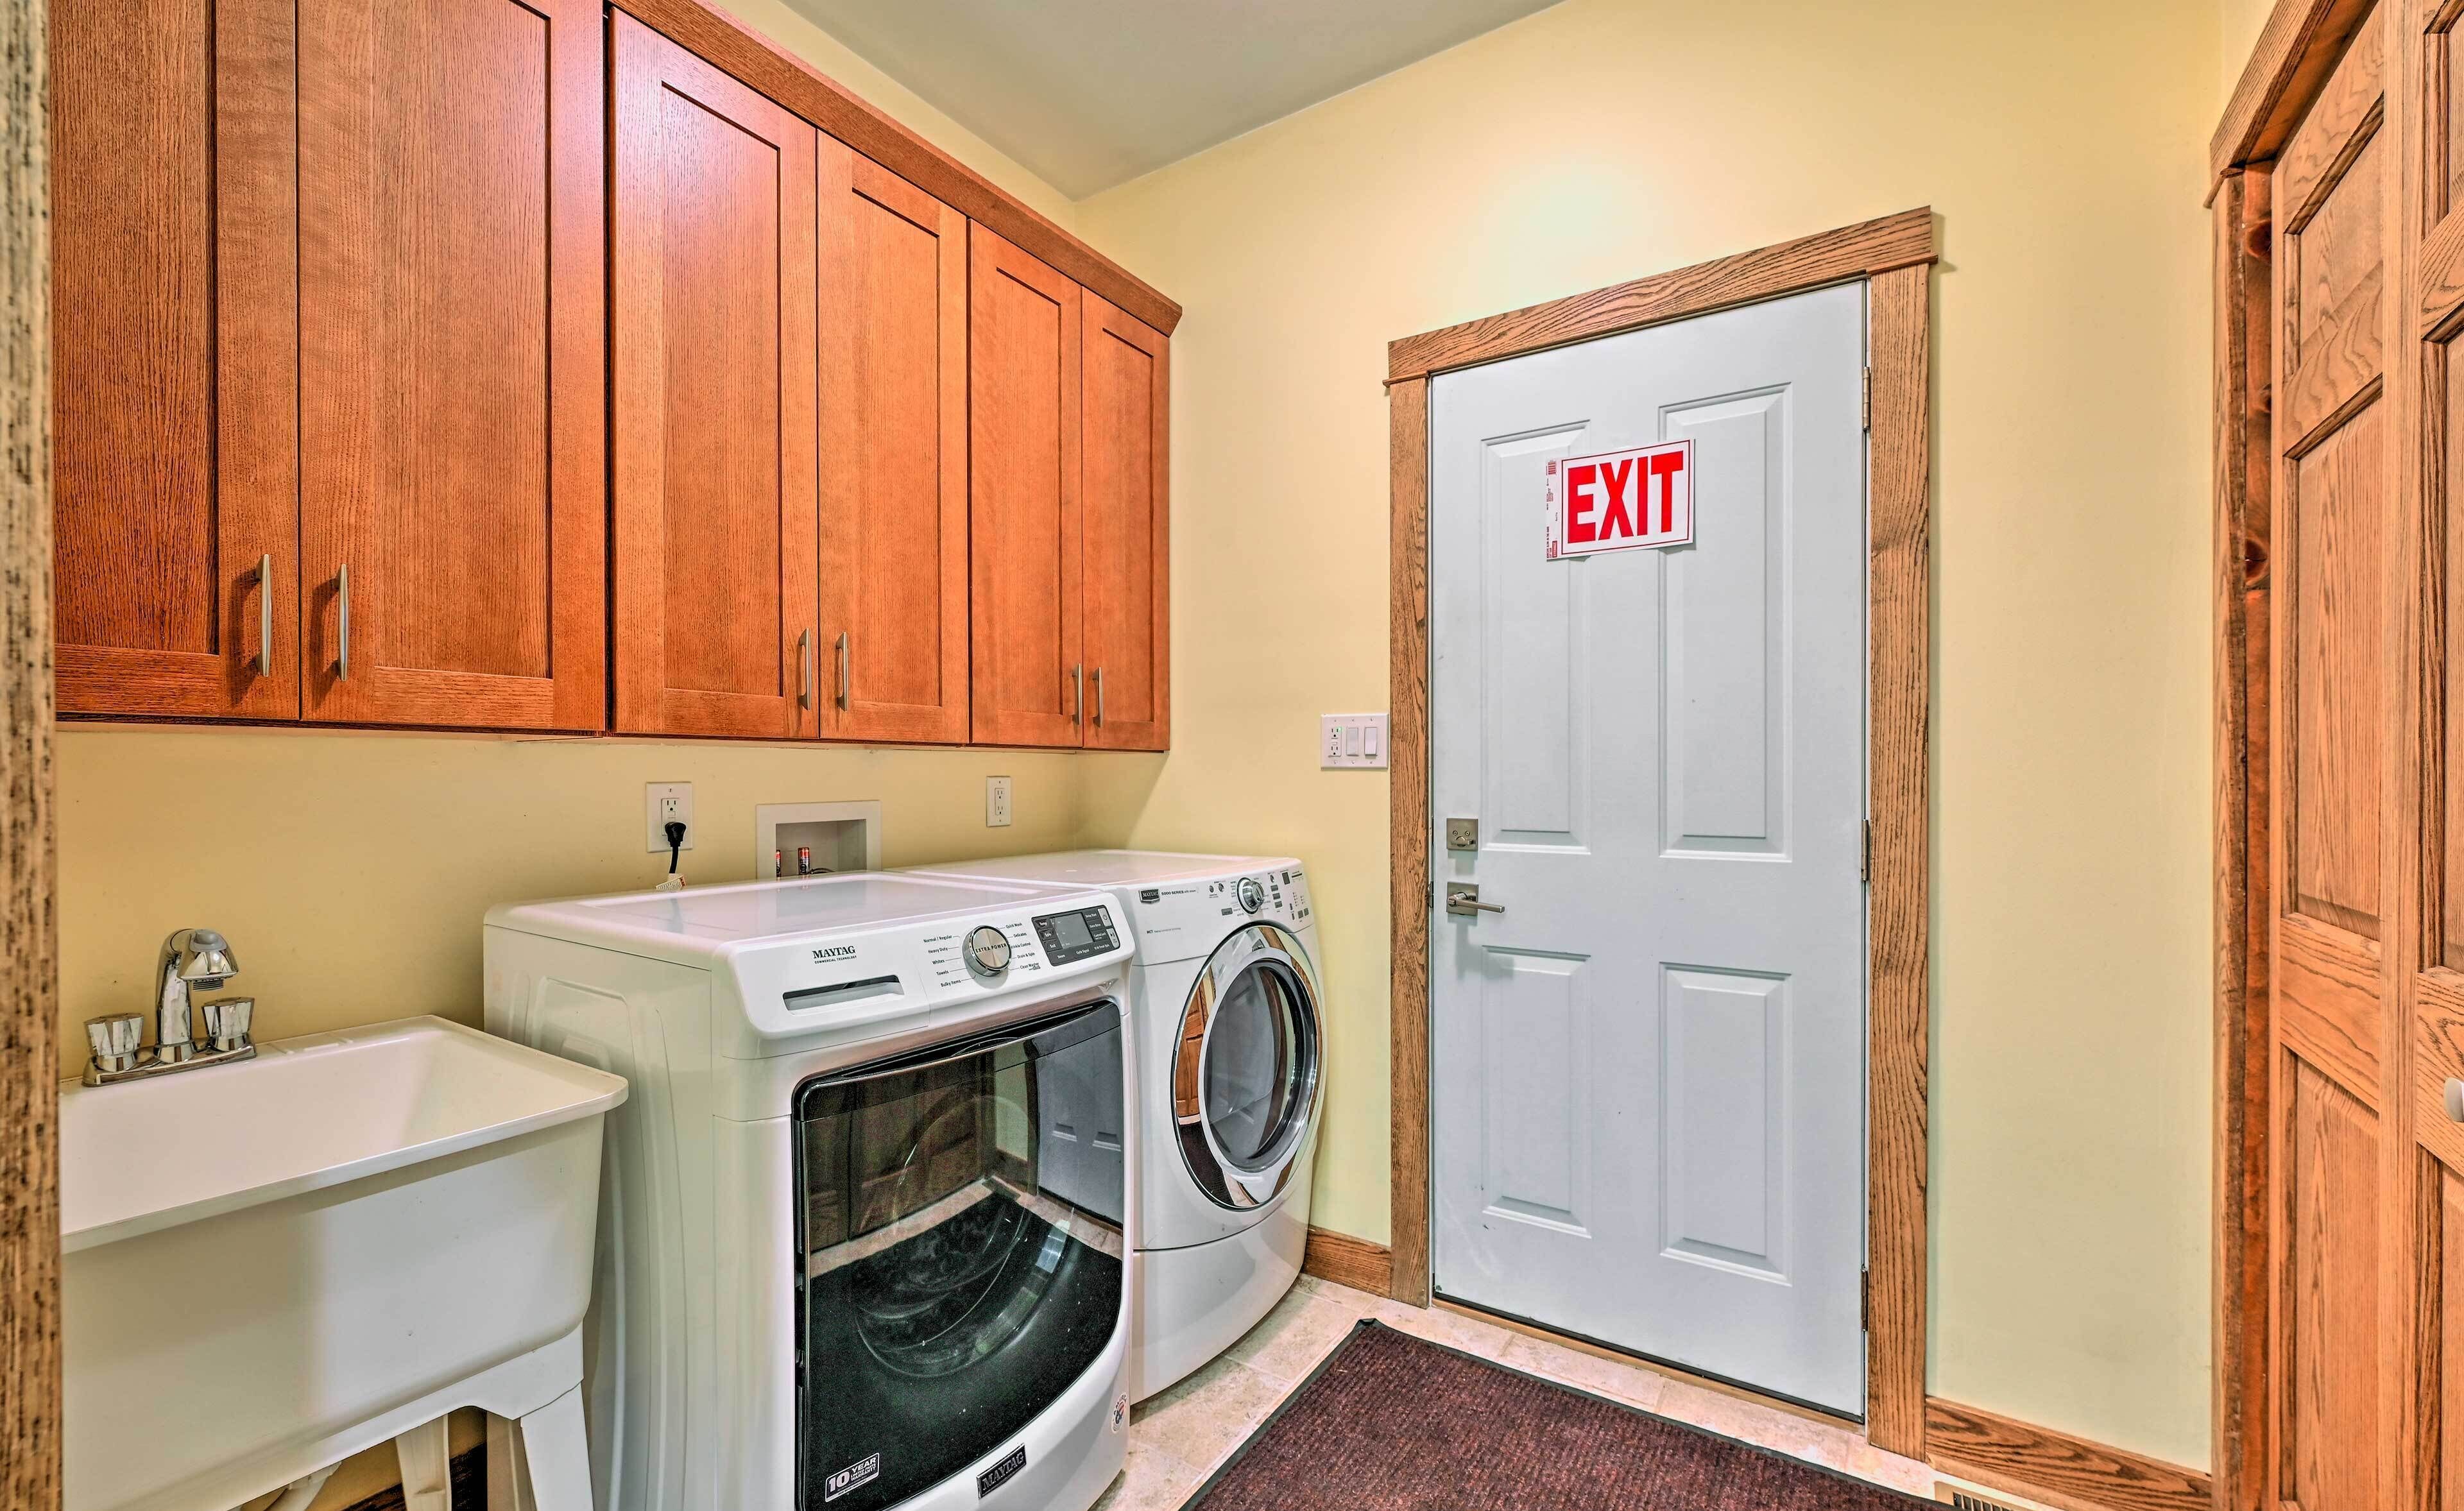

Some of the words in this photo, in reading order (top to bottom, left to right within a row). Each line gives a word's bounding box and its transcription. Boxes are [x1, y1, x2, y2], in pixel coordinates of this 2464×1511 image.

[1568, 450, 1684, 543] EXIT
[812, 946, 855, 959] MAYTAG
[829, 1471, 850, 1492] 10
[851, 1457, 877, 1474] YEAR
[851, 1466, 876, 1481] WARRANTY
[982, 1451, 1024, 1491] MAYTAG
